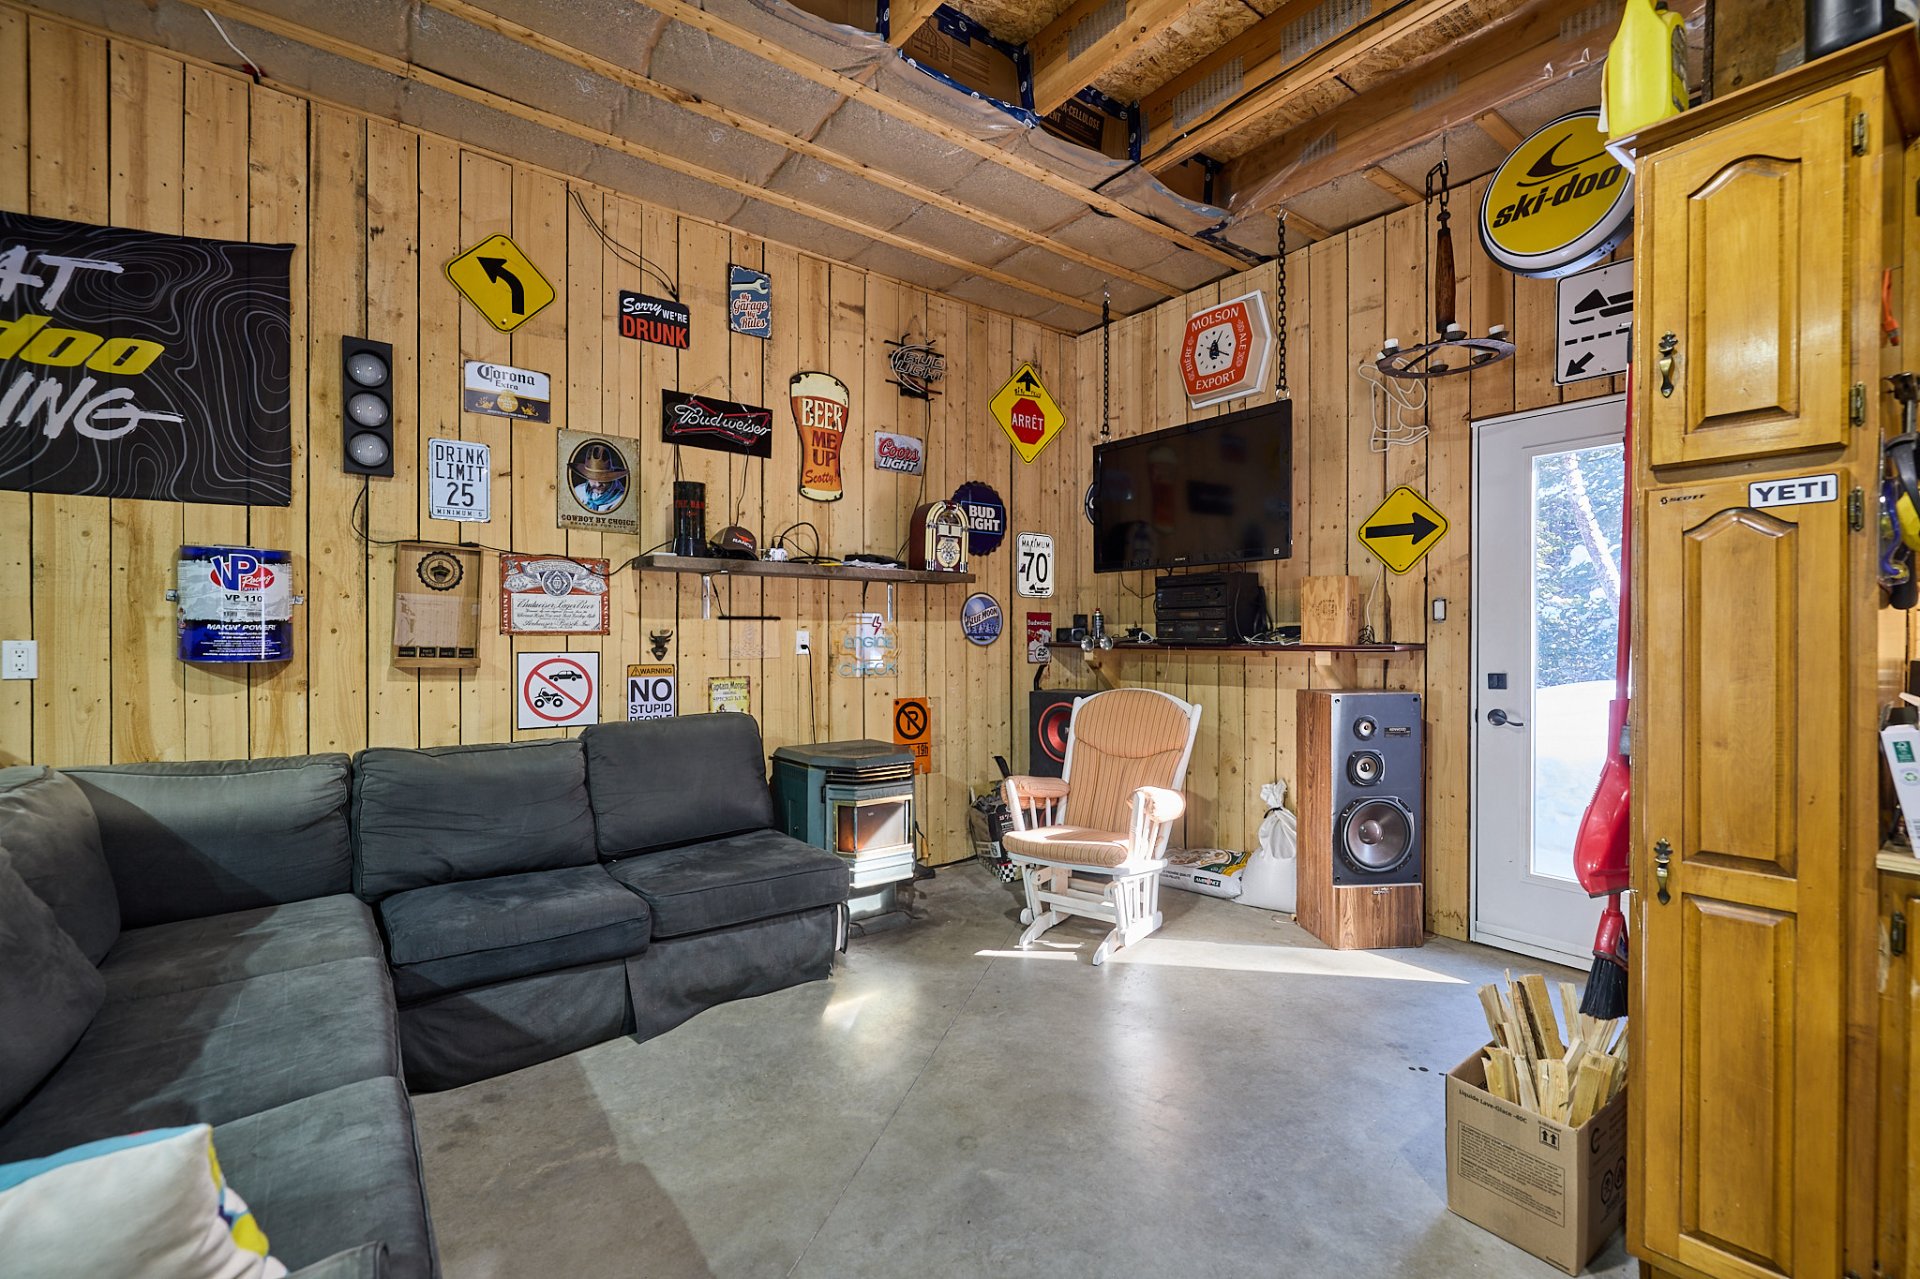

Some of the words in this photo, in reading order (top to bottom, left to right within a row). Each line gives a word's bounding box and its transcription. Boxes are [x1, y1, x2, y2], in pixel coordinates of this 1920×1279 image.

[1493, 164, 1623, 229] ski-doo
[623, 297, 663, 316] Sorry
[662, 309, 688, 324] WE'RE
[733, 299, 768, 314] Garage
[741, 317, 767, 329] Rules
[1192, 306, 1239, 332] MOLSON
[623, 315, 687, 350] DRUNK
[896, 359, 948, 381] LIGHT
[903, 351, 947, 370] BUD
[477, 364, 536, 386] Corona
[1195, 369, 1236, 390] EXPORT
[495, 380, 519, 391] Extra
[674, 404, 772, 436] Budweiser
[802, 398, 843, 433] BEER
[1012, 412, 1044, 431] ARRÊT
[812, 429, 838, 450] ME
[436, 445, 485, 466] DRINK
[813, 449, 837, 467] UP
[879, 438, 920, 462] Coors
[436, 462, 485, 482] LIMIT
[880, 457, 916, 472] LIGHT
[446, 482, 475, 507] 25
[1755, 480, 1829, 502] YETI
[437, 508, 473, 517] MINIMUM
[561, 514, 594, 523] COWBOY
[607, 518, 636, 527] CHOICE
[968, 504, 996, 519] BUD
[968, 518, 1001, 531] IGHT
[1021, 538, 1050, 549] MAXIMUM
[210, 553, 259, 591] VP
[1023, 551, 1048, 583] 70
[982, 606, 998, 620] MOON
[640, 667, 672, 675] WARNING
[630, 678, 672, 703] NO
[630, 703, 672, 715] STUPID
[1459, 1089, 1480, 1103] Liquide
